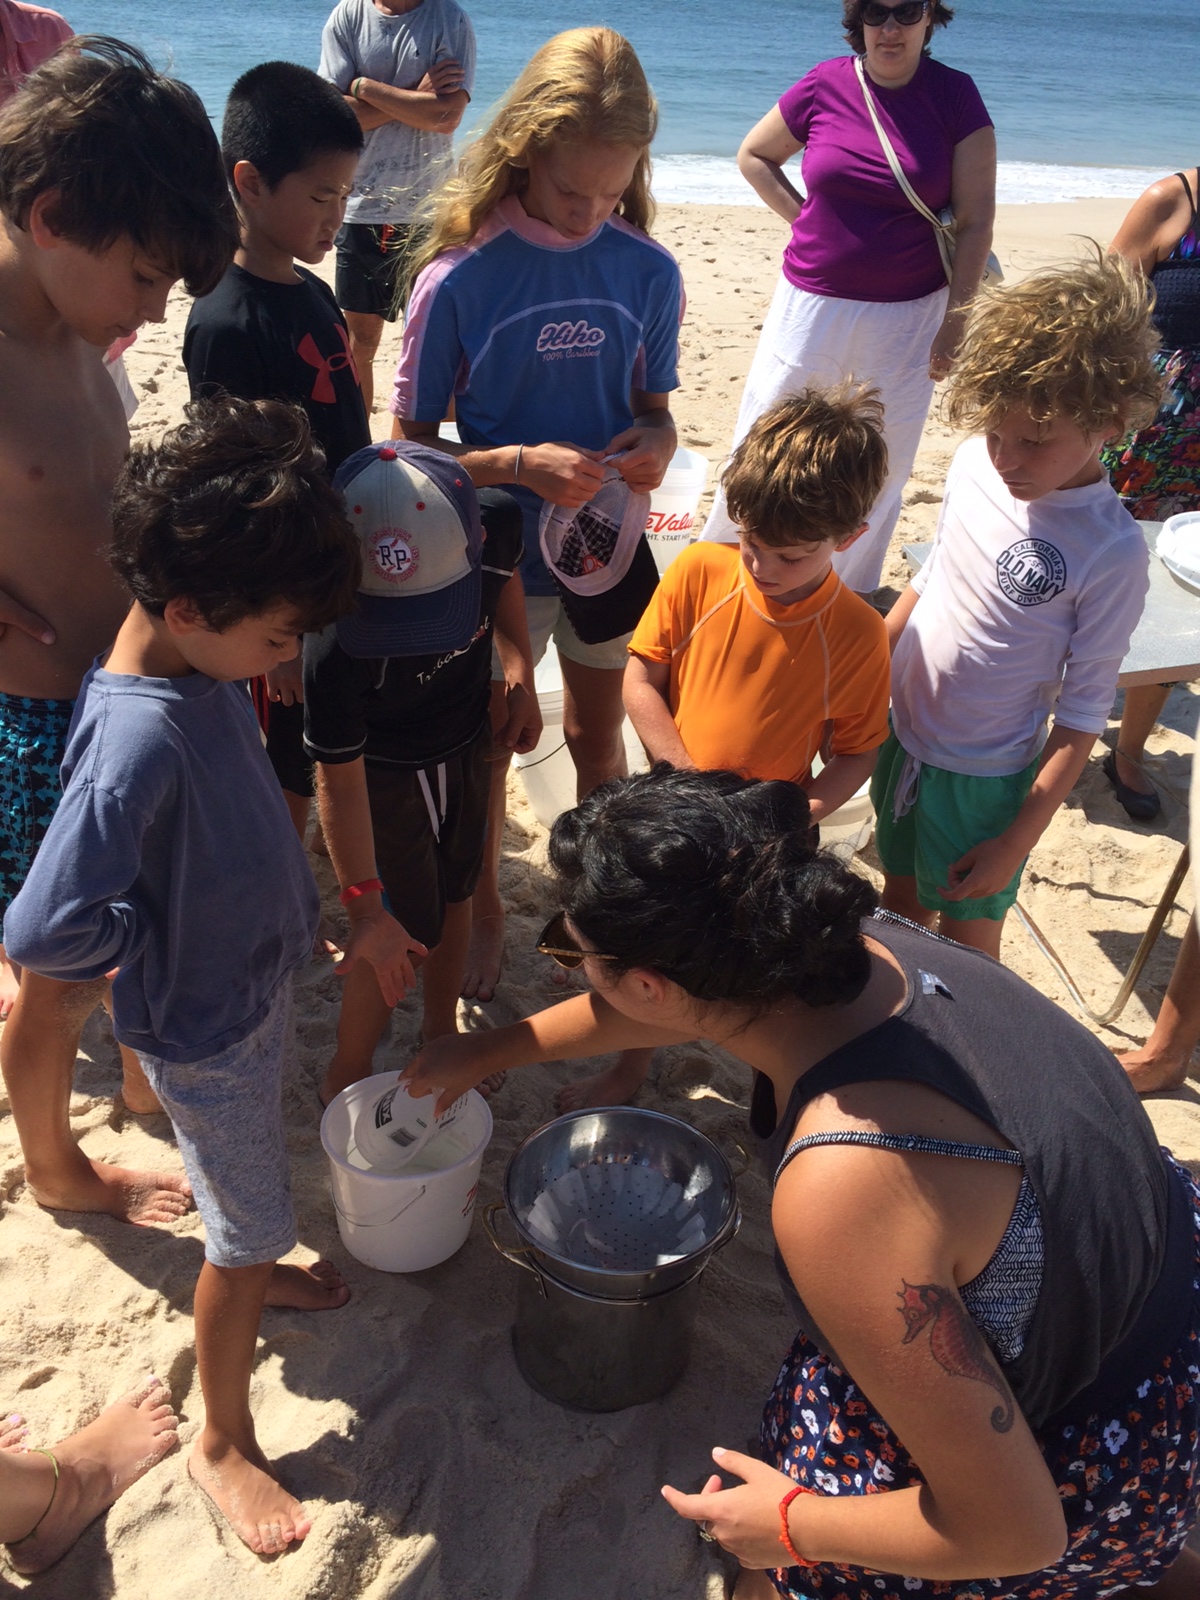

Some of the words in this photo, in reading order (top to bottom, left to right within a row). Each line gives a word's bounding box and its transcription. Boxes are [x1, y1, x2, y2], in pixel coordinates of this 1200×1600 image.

[538, 320, 605, 351] Hiho
[542, 351, 564, 361] 100%
[661, 533, 681, 541] START
[379, 545, 407, 570] RP
[1013, 541, 1061, 567] CALIFORNIA
[996, 550, 1025, 576] OLD
[1021, 567, 1065, 595] NAVY
[999, 570, 1015, 595] SURF
